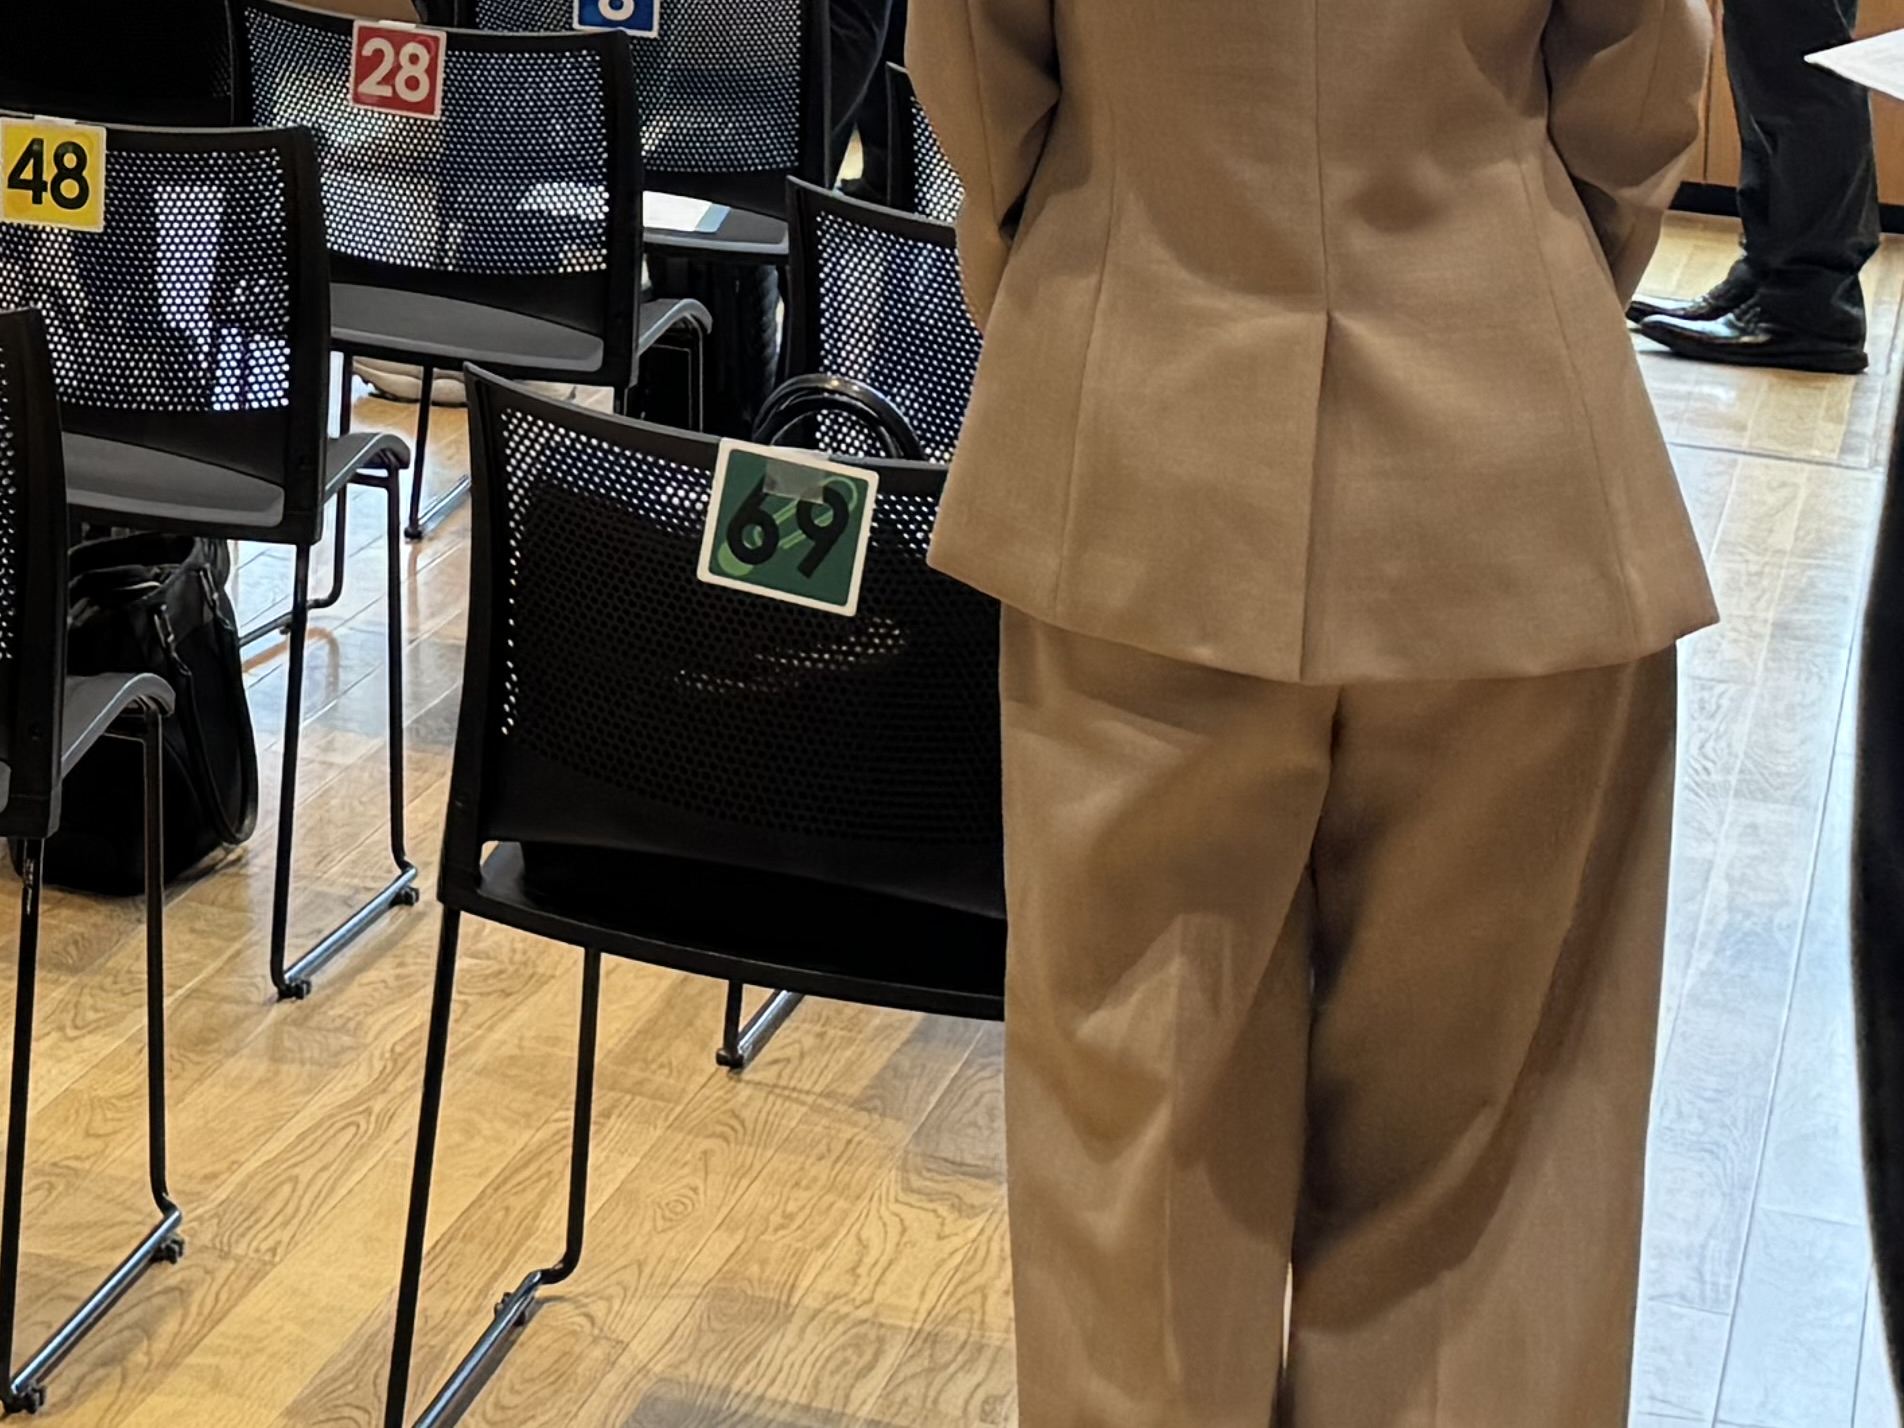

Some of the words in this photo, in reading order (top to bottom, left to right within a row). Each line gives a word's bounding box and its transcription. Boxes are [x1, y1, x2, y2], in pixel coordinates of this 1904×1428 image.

[356, 35, 433, 104] 28
[5, 140, 91, 213] 48
[726, 483, 852, 583] 69
